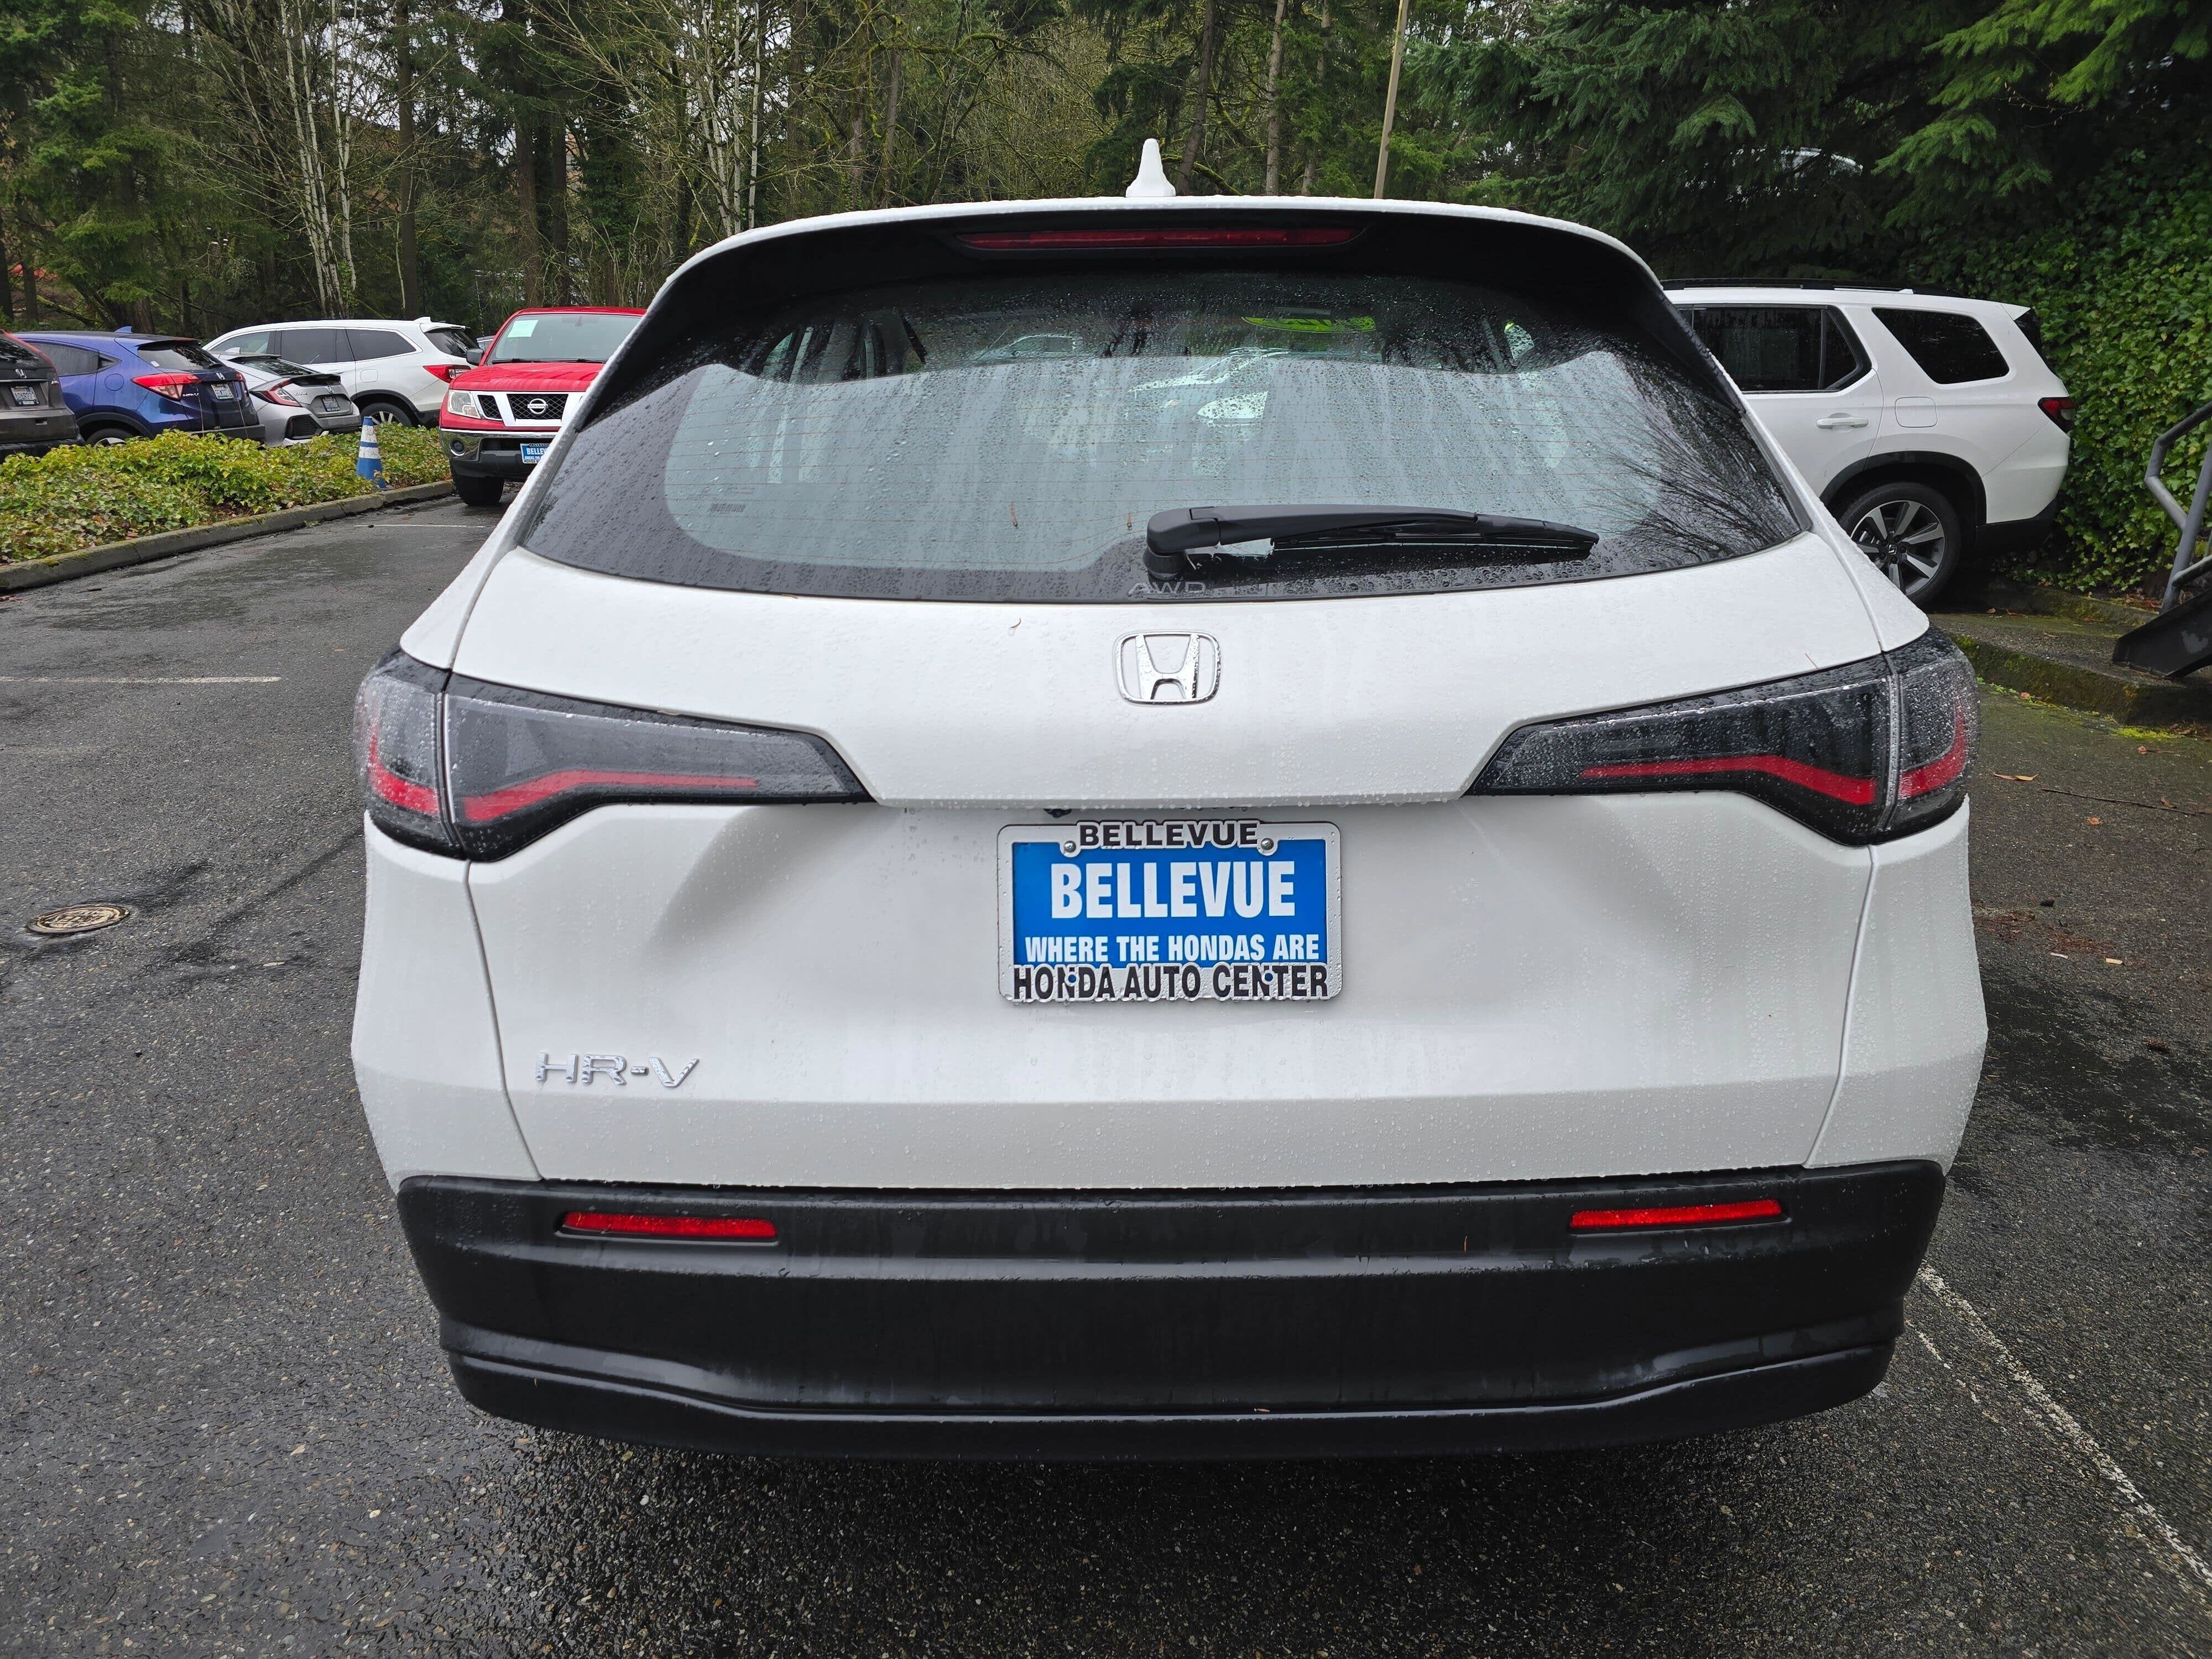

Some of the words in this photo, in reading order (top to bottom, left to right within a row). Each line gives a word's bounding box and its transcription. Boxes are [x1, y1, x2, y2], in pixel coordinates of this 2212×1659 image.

[1128, 581, 1206, 597] AWD
[1079, 822, 1259, 846] BELLEVUE
[1051, 860, 1295, 919] BELLEVUE
[1025, 936, 1108, 962] WHERE
[1116, 936, 1160, 962] THE
[1170, 935, 1265, 962] HONDAS
[1273, 933, 1319, 960] ARE
[1014, 965, 1116, 1000] HONDA
[1124, 965, 1201, 998] AUTO
[1212, 964, 1328, 997] CENTER
[535, 1052, 700, 1088] HR-V
